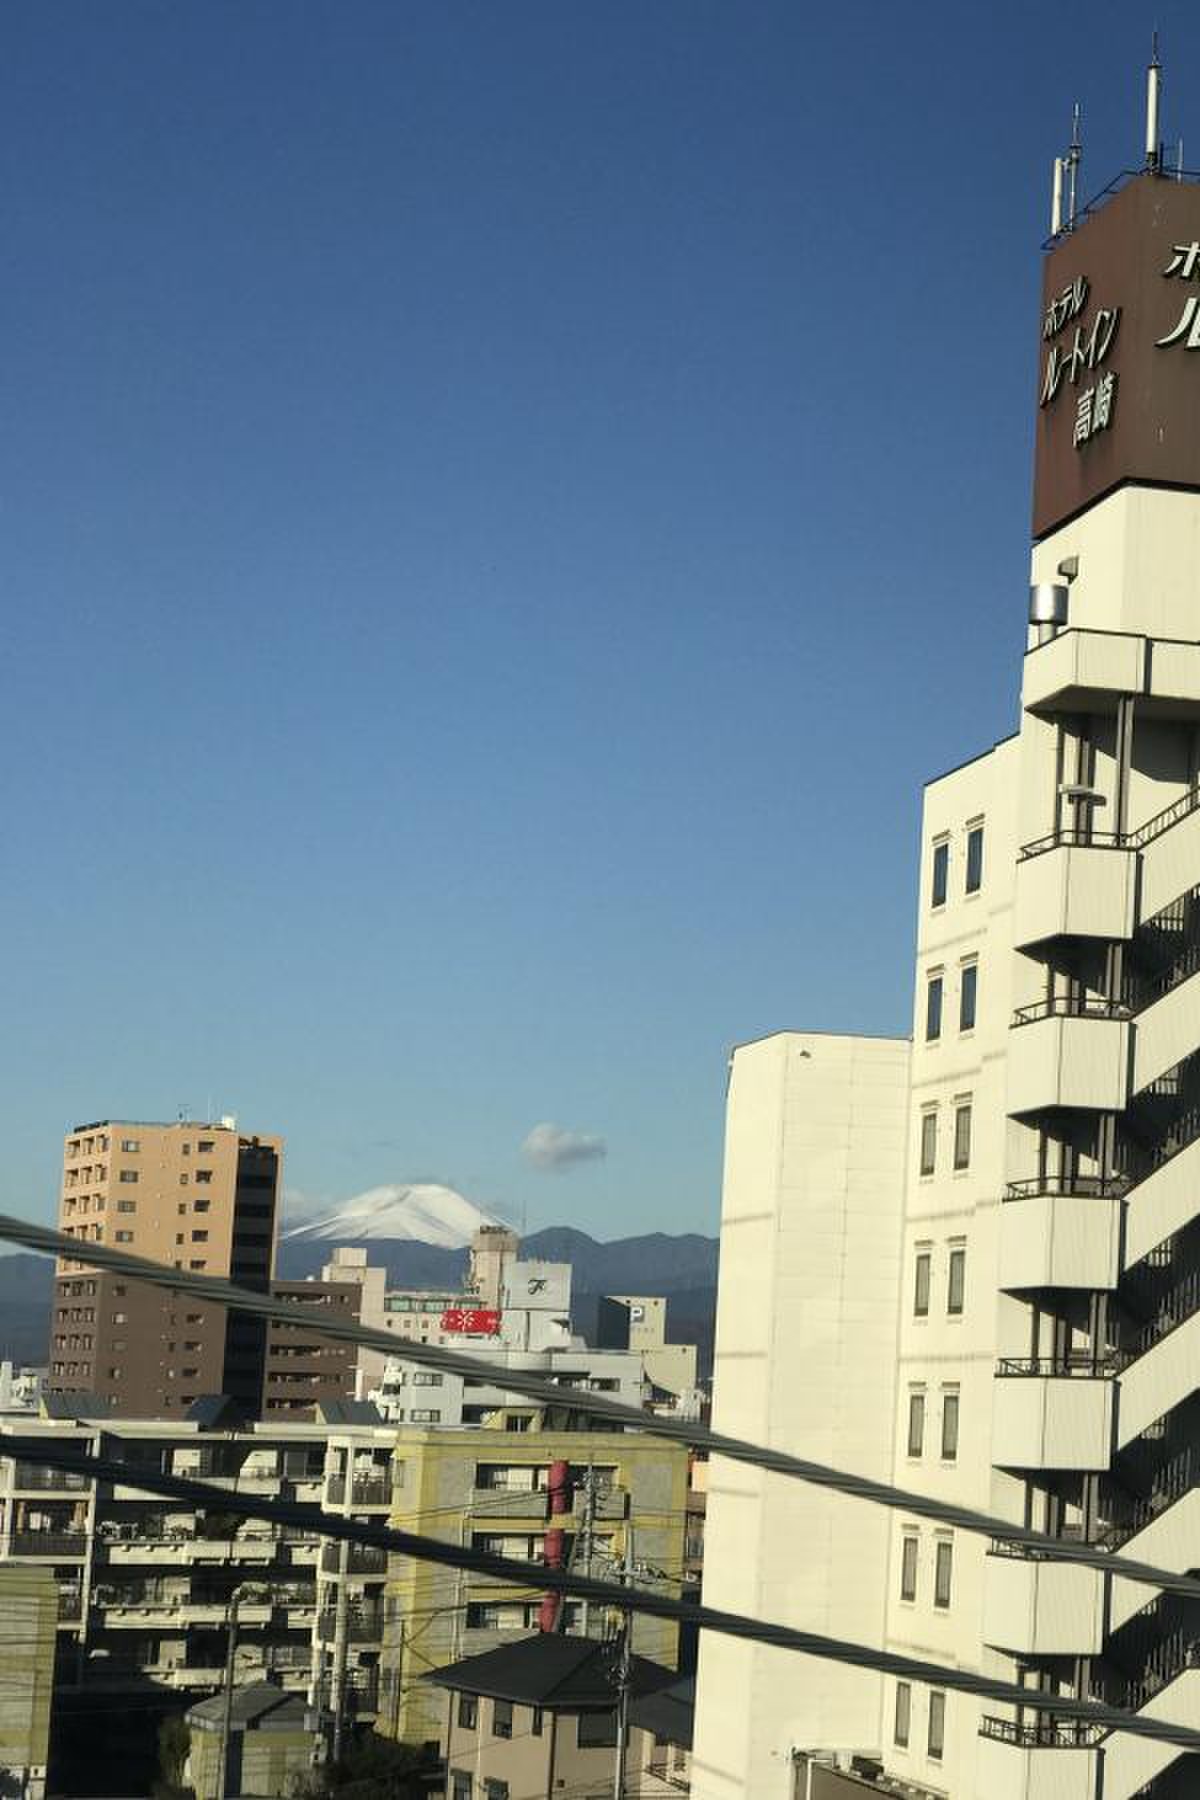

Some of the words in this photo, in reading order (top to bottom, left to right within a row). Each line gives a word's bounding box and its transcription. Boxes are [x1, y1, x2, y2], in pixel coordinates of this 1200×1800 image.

[1043, 275, 1089, 341] ホテル
[1040, 306, 1121, 408] ルートイン
[1073, 371, 1119, 450] 高崎
